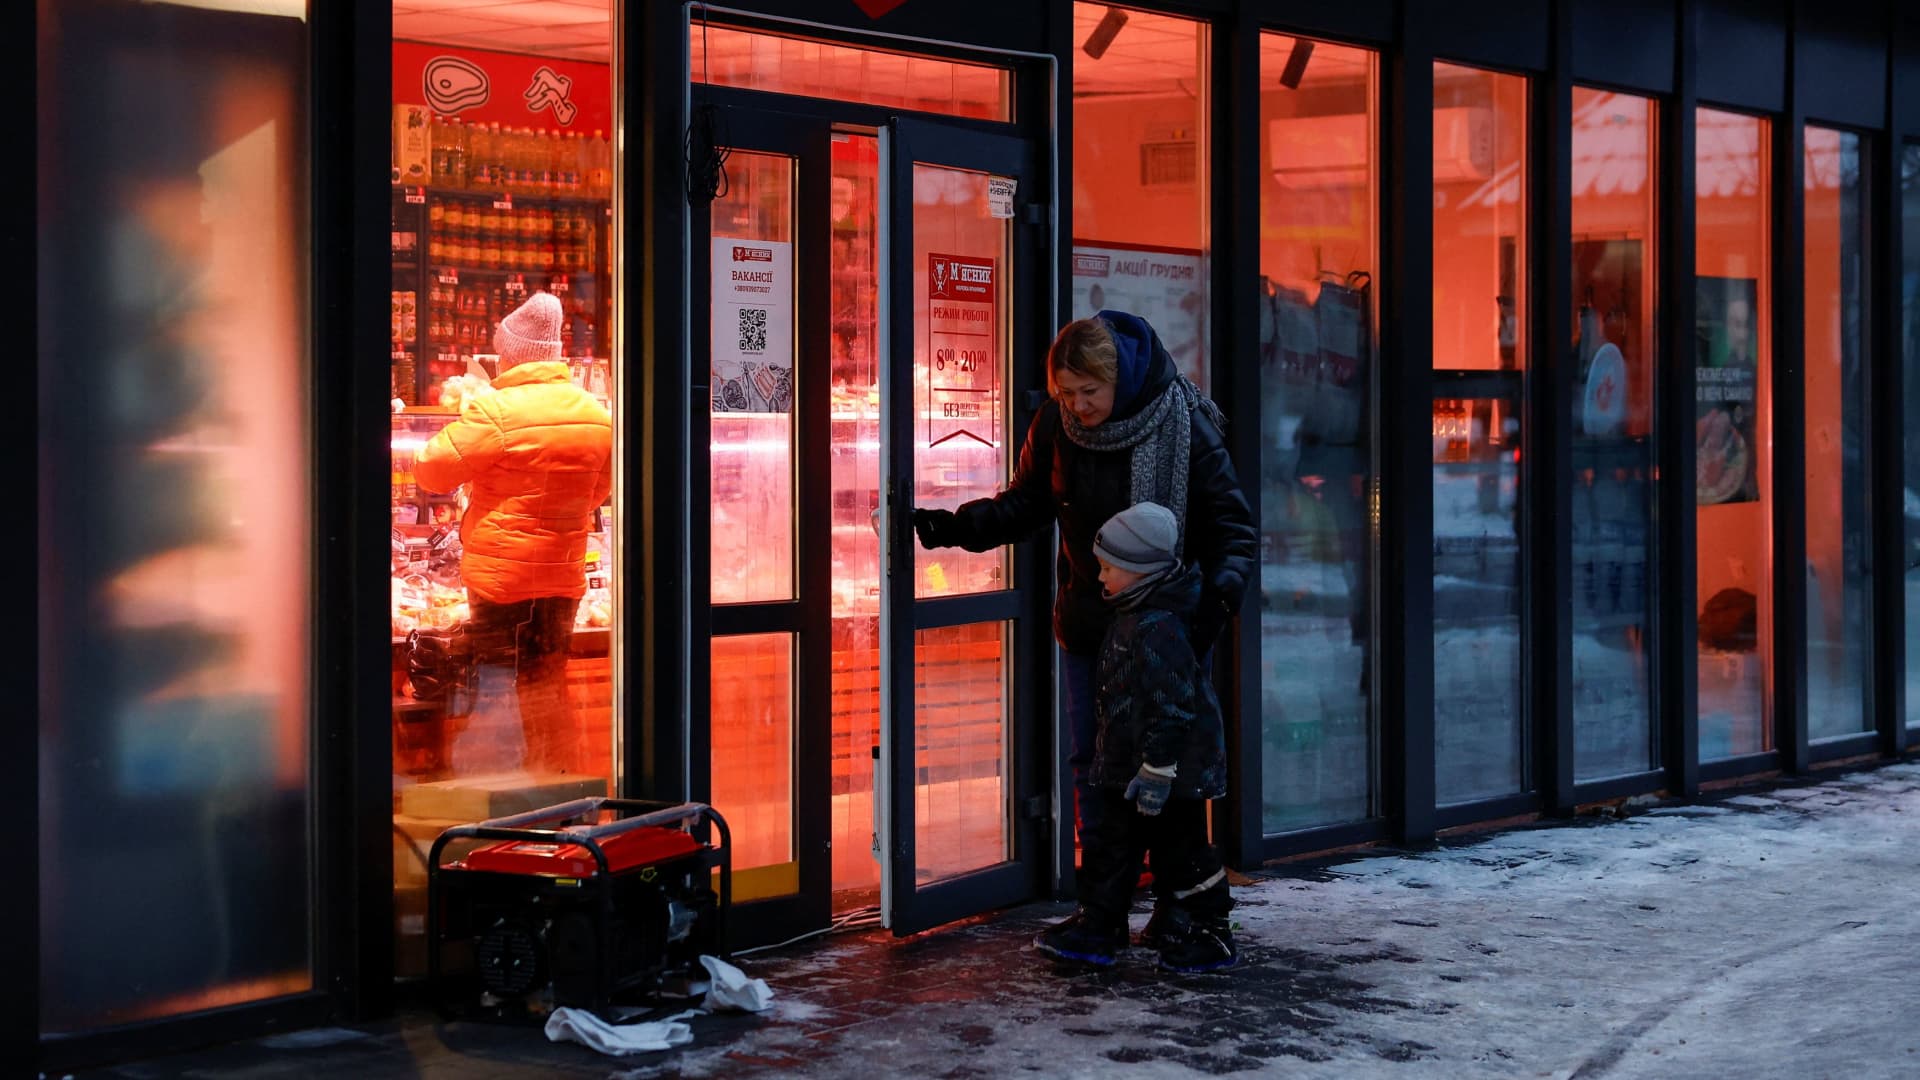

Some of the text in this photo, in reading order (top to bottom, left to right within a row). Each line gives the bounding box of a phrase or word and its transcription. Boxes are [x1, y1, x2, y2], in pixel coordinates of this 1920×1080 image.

[950, 262, 992, 283] М'ЯСНИК
[1114, 259, 1149, 277] АКЦІЇ
[732, 271, 773, 282] ВАКАНСІЇ
[934, 307, 989, 322] РЕЖИМ РОБОТИ
[944, 403, 960, 417] БЕЗ
